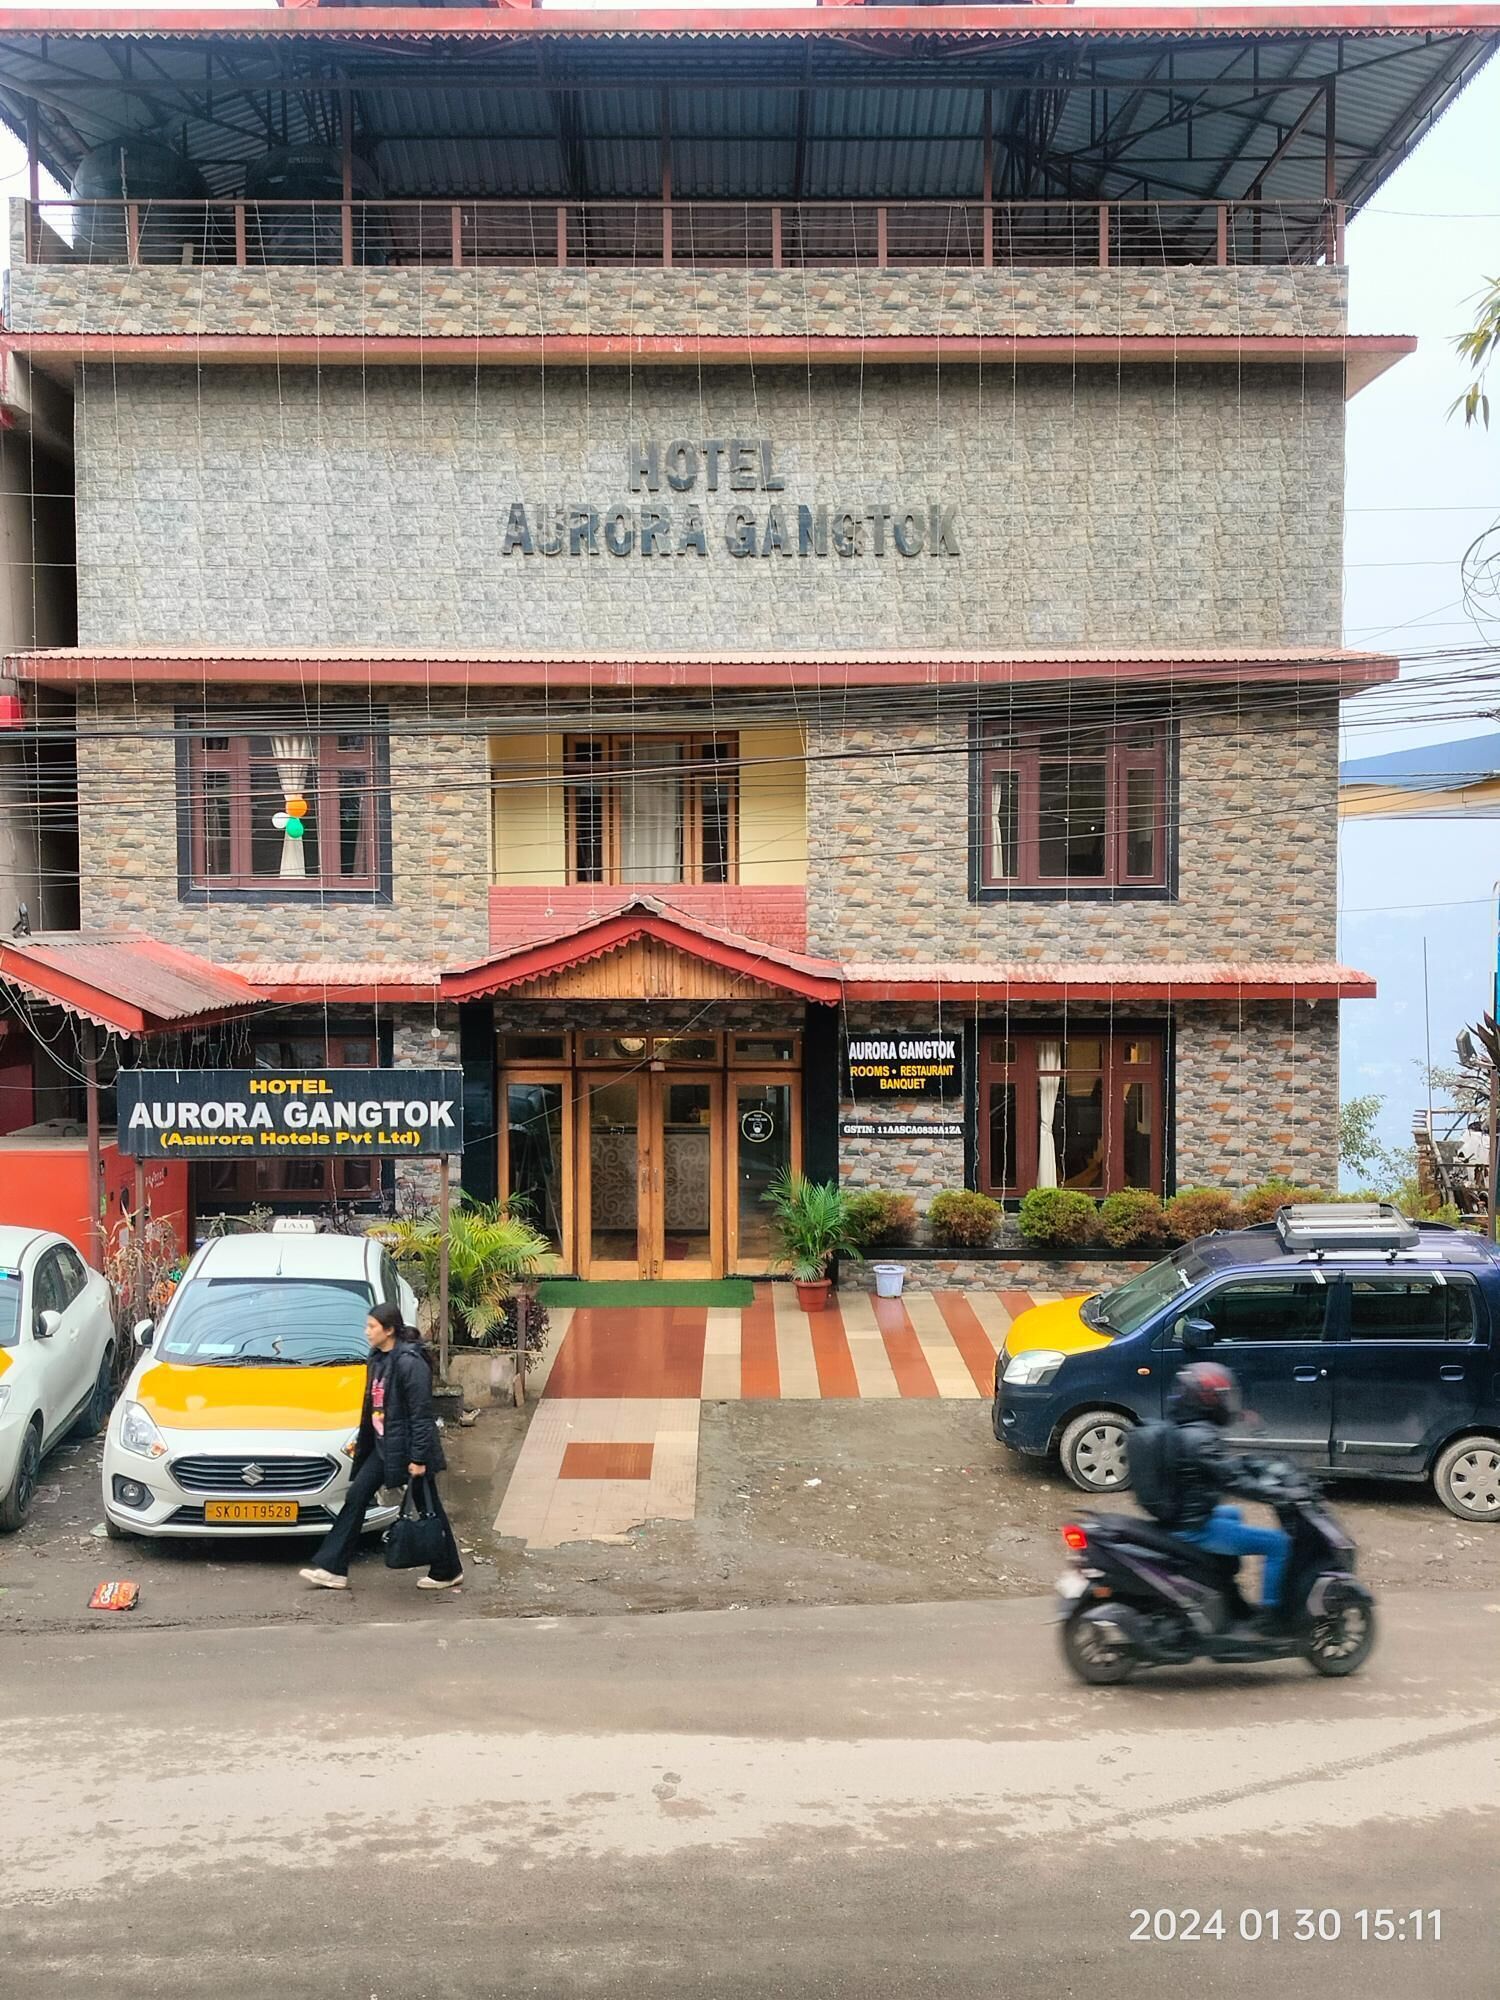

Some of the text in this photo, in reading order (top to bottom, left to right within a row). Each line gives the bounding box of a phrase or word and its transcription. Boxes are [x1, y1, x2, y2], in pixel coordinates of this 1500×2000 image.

[629, 438, 785, 492] HOTEL
[502, 502, 960, 557] AURORA GANGTOK
[849, 1041, 955, 1060] AURORA GANGTOK
[850, 1065, 954, 1076] ROOMS RESTAURANT
[249, 1079, 333, 1095] HOTEL
[880, 1078, 926, 1089] BANQUET
[128, 1101, 456, 1129] AURORA GANGTOK
[843, 1125, 876, 1134] GSTIN:
[160, 1130, 421, 1148] (Aaurora Hotels Pvt Ltd)
